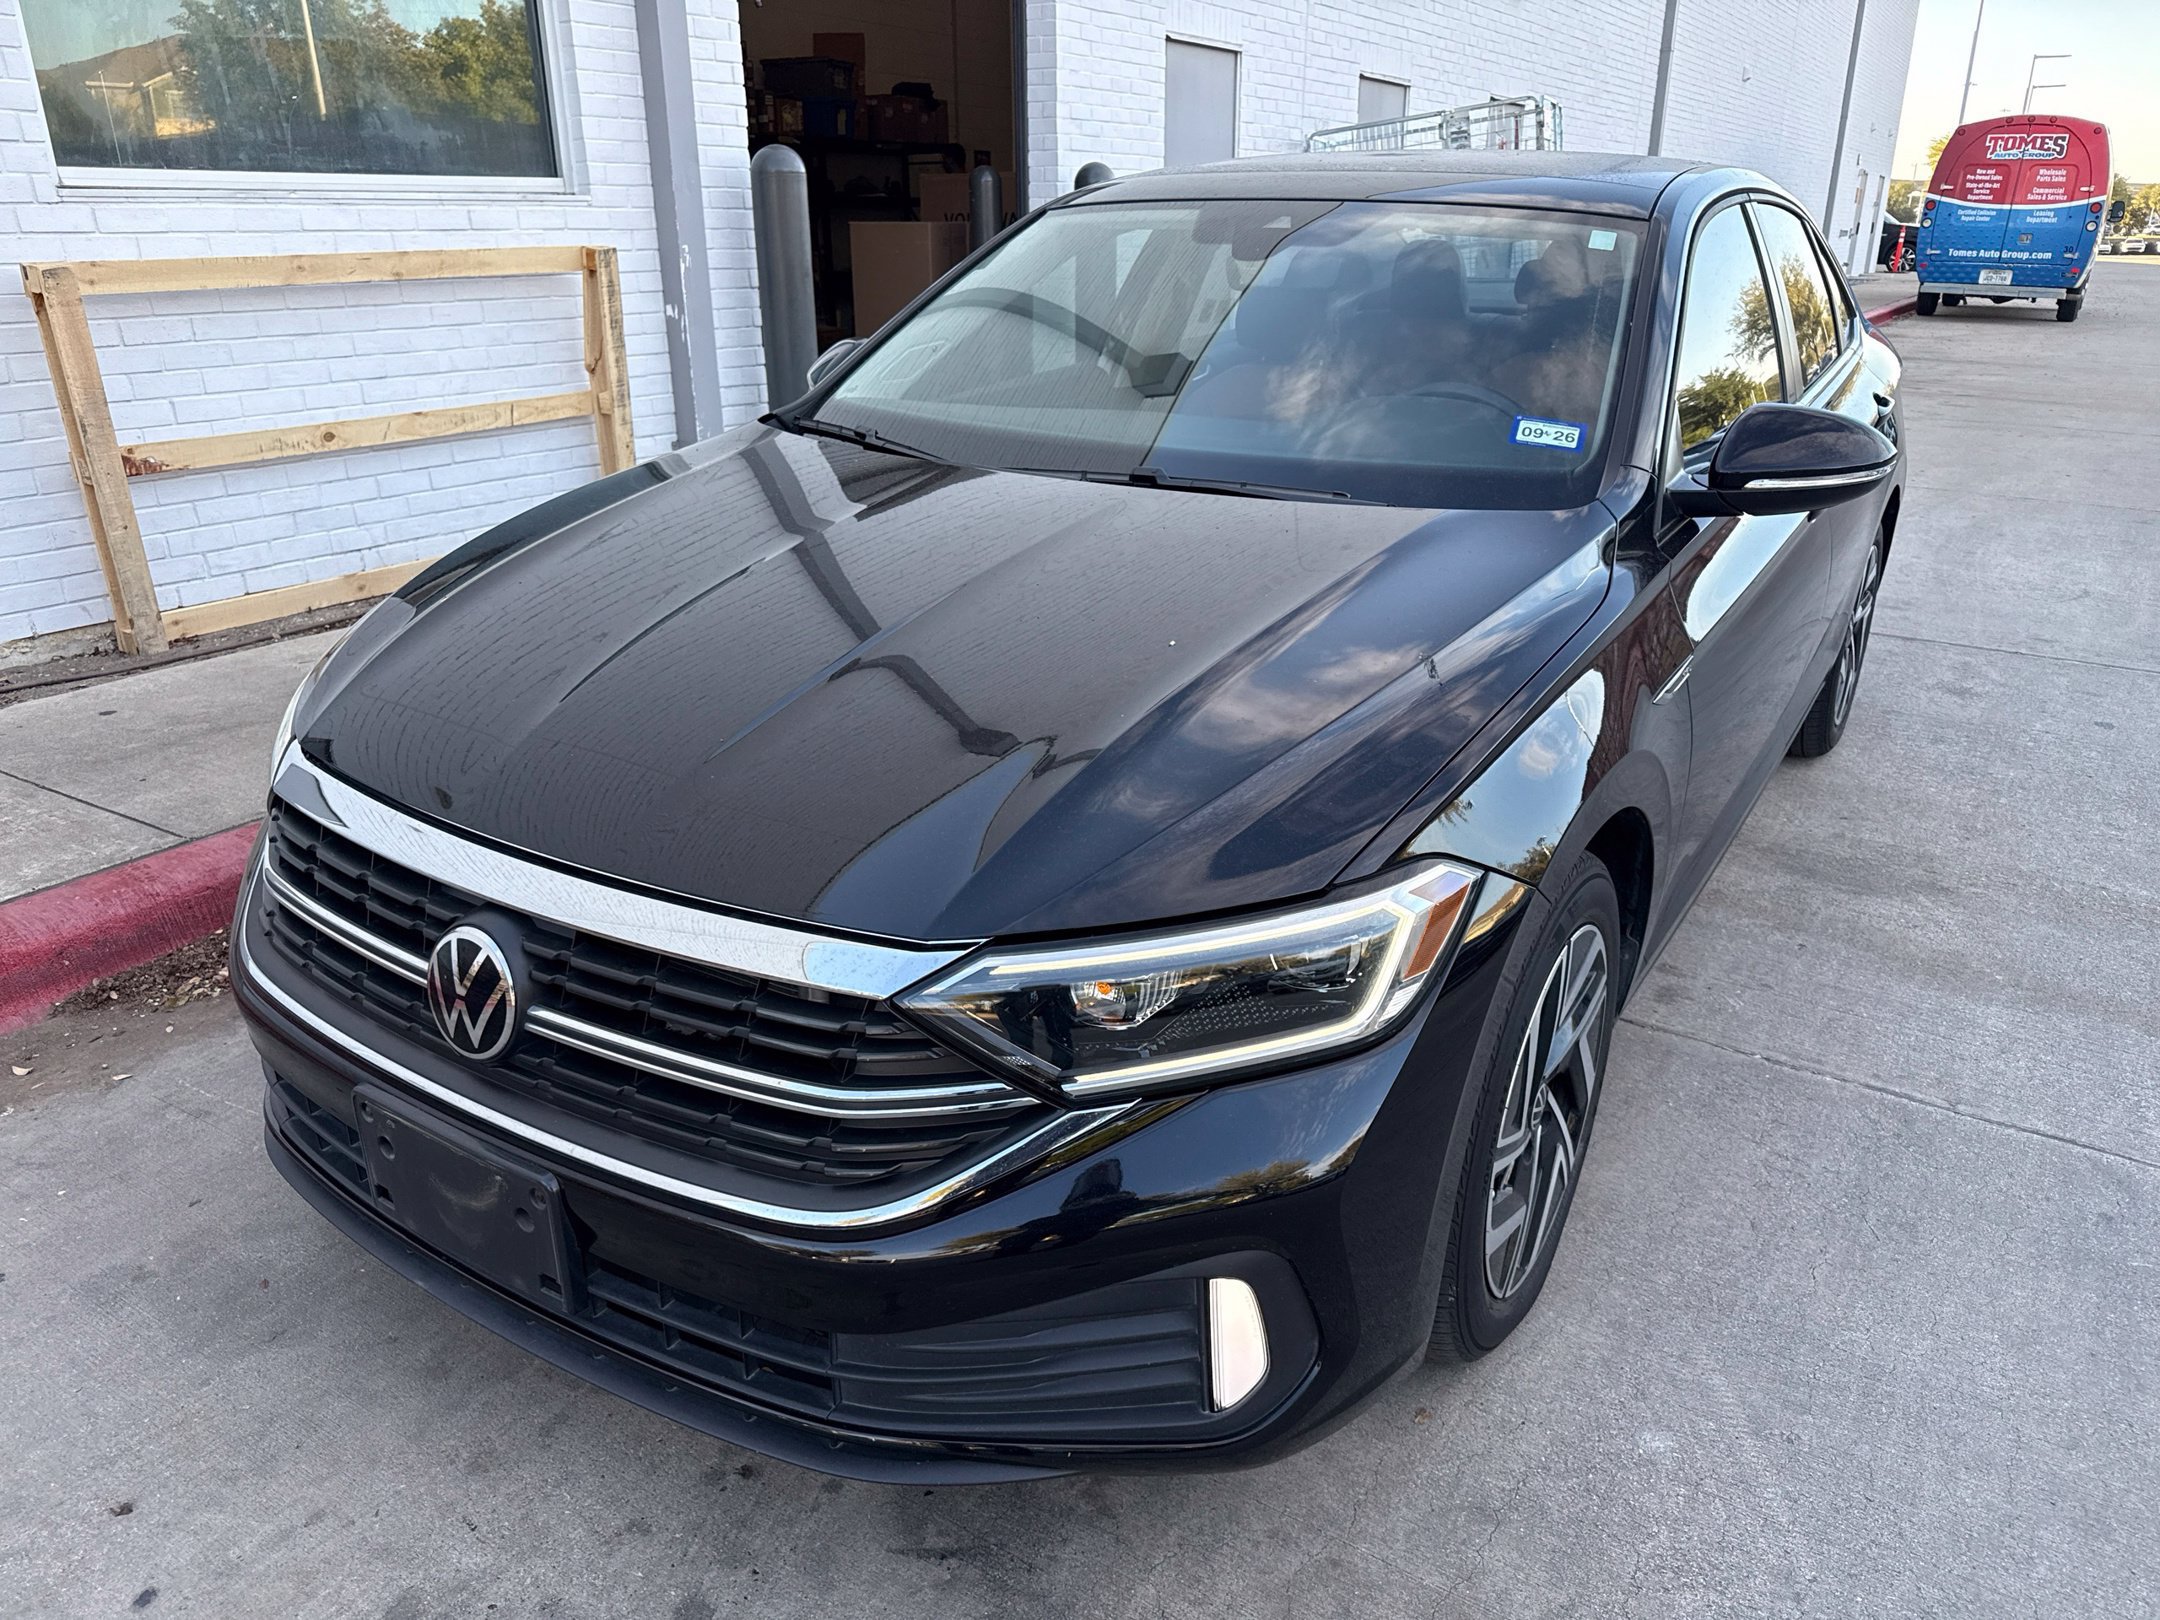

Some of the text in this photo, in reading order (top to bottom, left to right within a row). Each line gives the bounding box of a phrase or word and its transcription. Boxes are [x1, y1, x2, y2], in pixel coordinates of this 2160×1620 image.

[1987, 135, 2068, 157] TOMES
[1948, 248, 2052, 260] Tomes Auto Group.com
[2063, 245, 2074, 253] 30
[1521, 426, 1544, 438] 09
[1553, 430, 1576, 443] 26
